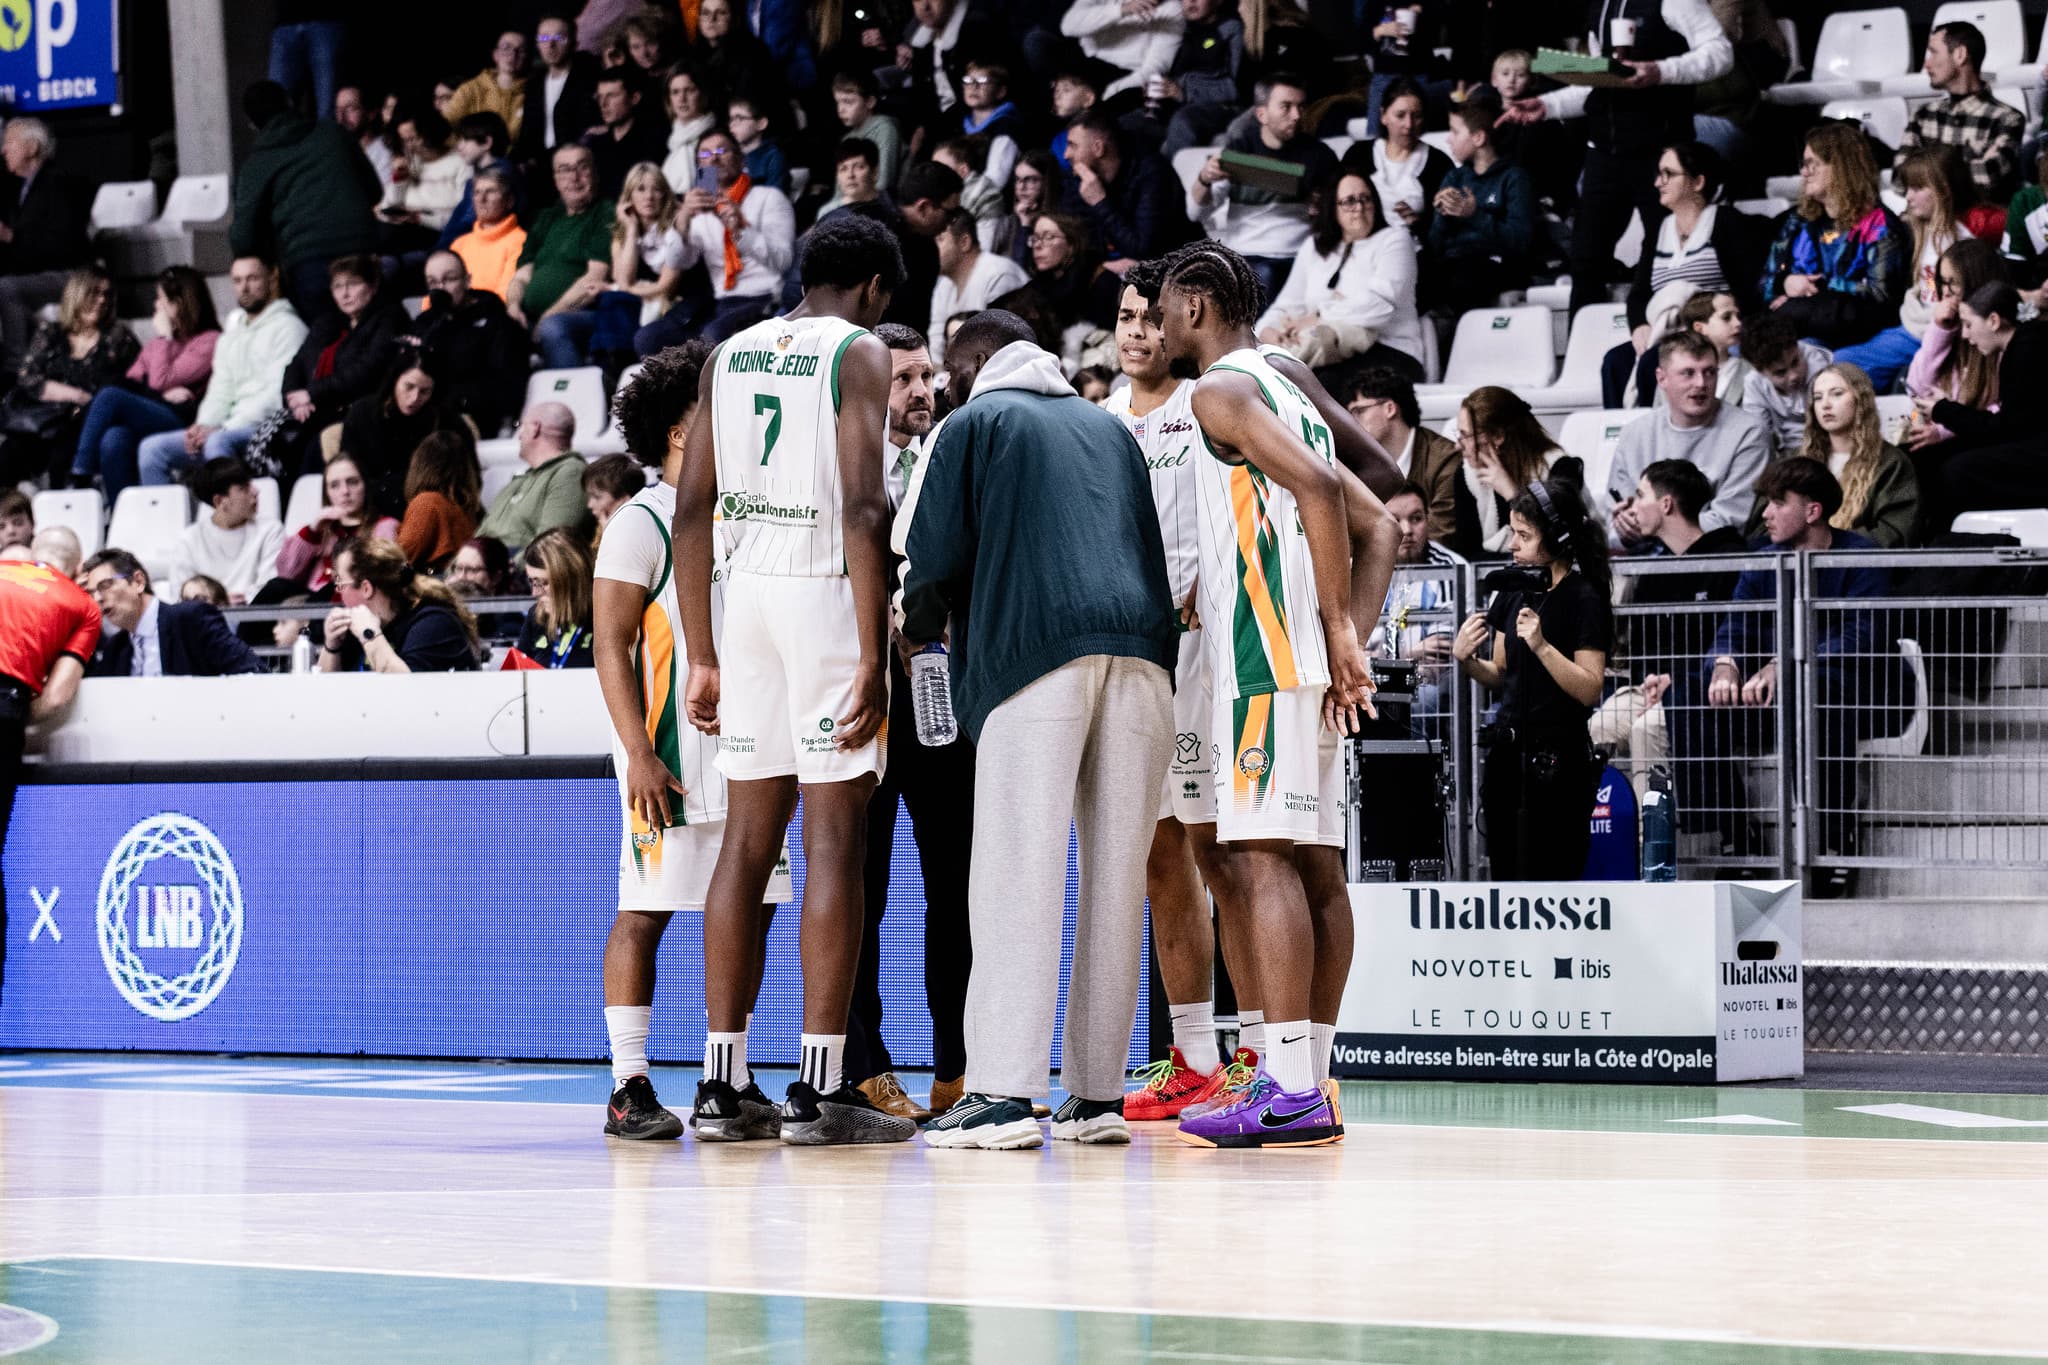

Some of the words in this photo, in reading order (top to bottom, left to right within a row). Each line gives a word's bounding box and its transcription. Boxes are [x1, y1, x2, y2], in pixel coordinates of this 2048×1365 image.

[38, 77, 97, 102] BERCK
[754, 393, 782, 466] 7
[1147, 445, 1190, 470] rtel
[821, 720, 832, 729] 62
[730, 735, 756, 743] Dandre
[801, 735, 837, 745] Pas-de-C
[1590, 819, 1612, 834] LITE
[136, 885, 204, 948] LNB
[1402, 888, 1612, 930] Thalassa
[1412, 959, 1532, 978] NOVOTEL
[1581, 959, 1611, 979] ibis
[1720, 961, 1798, 985] Thalassa
[1723, 1000, 1769, 1012] NOVOTEL
[1785, 998, 1798, 1010] ibis
[1412, 1009, 1441, 1028] LE
[1464, 1010, 1612, 1030] TOUQUET
[1723, 1028, 1736, 1041] LE
[1744, 1026, 1798, 1039] TOUQUET
[1333, 1045, 1381, 1064] Votre
[1384, 1046, 1451, 1065] adresse
[1456, 1047, 1538, 1067] bien-être
[1542, 1052, 1571, 1067] sur
[1575, 1048, 1591, 1068] la
[1595, 1047, 1637, 1068] Côte
[1641, 1048, 1713, 1072] d’Opale
